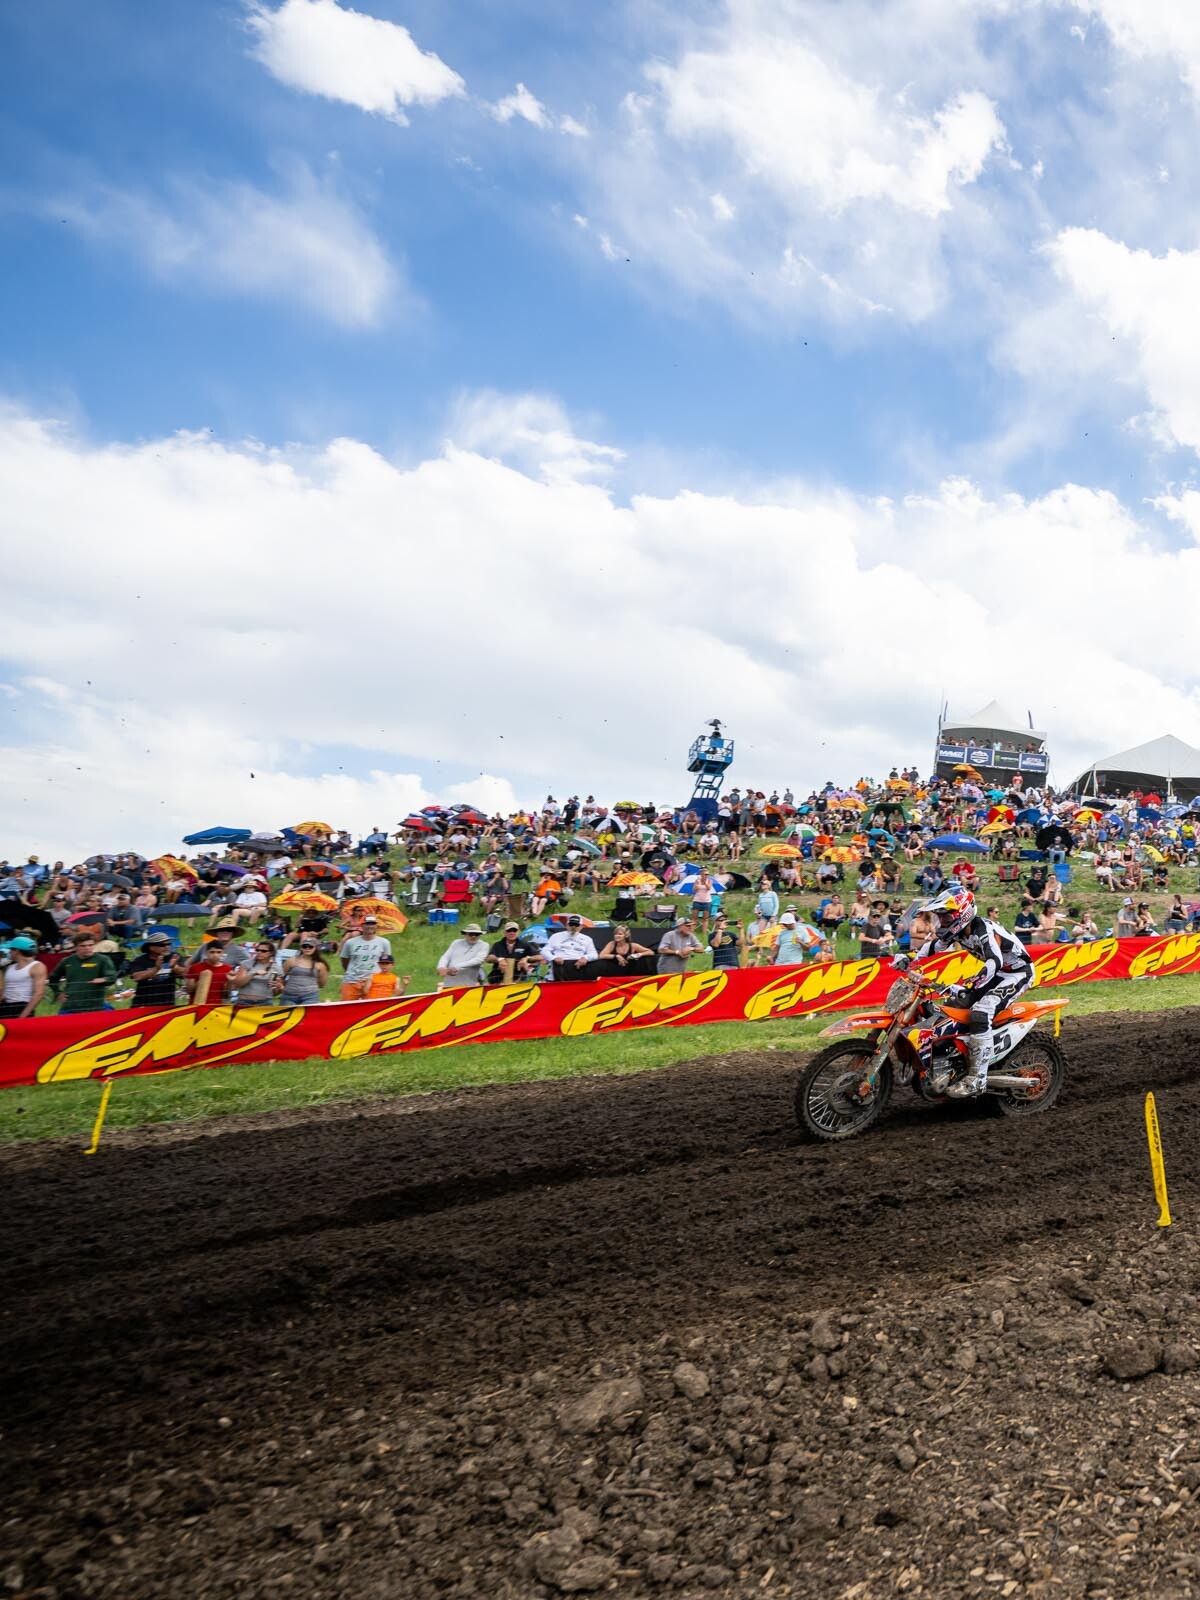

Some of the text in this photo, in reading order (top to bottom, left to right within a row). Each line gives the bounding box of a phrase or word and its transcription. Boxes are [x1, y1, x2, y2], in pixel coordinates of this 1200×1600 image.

[748, 958, 877, 1020] FMF
[1031, 938, 1116, 988] FMF
[340, 984, 535, 1059] FMF
[567, 970, 725, 1036] FMF
[50, 1005, 297, 1082] FMF
[993, 1028, 1012, 1055] 5
[1150, 1108, 1161, 1153] ACERBIS
